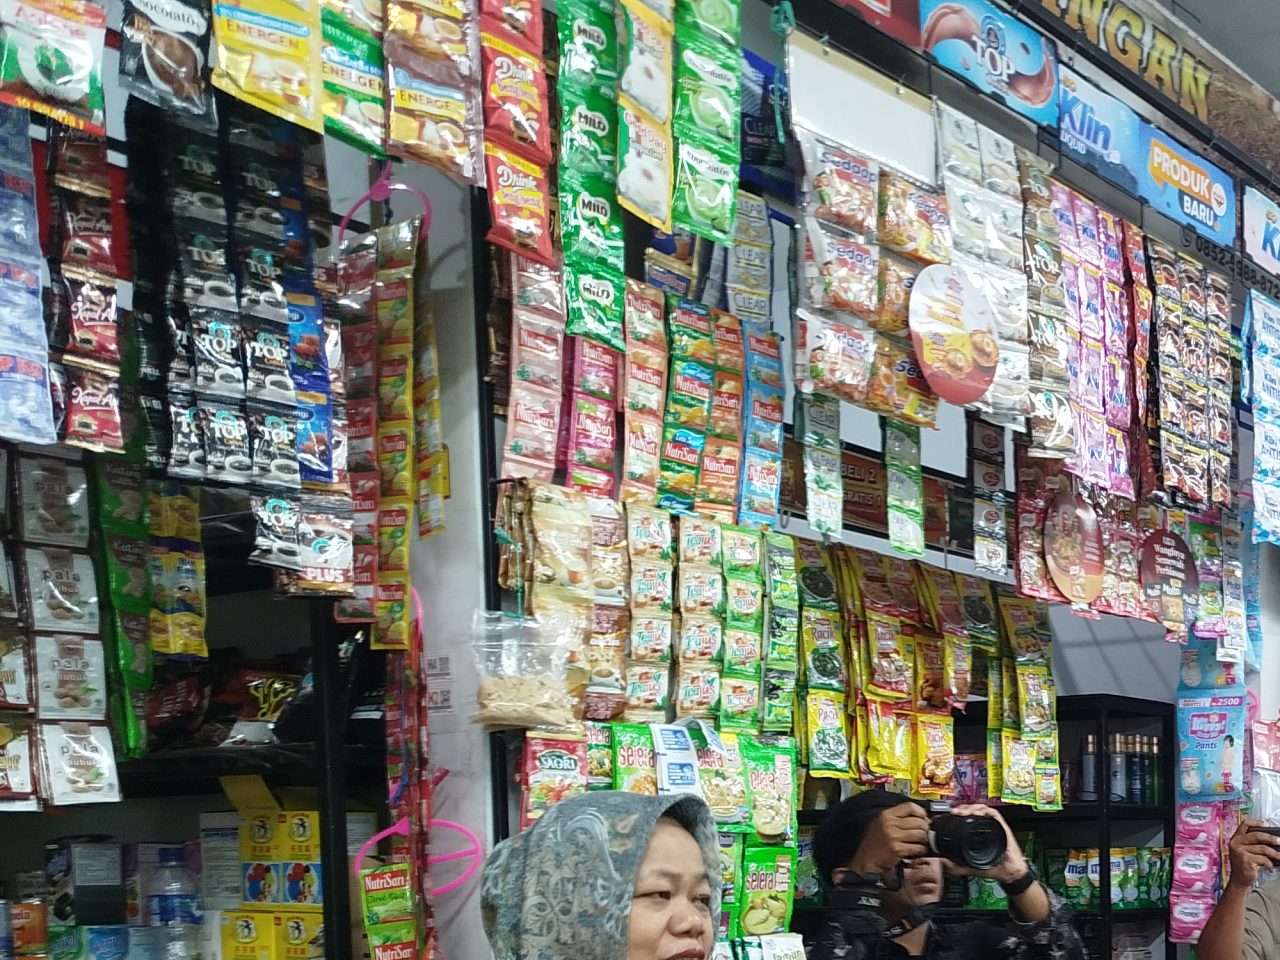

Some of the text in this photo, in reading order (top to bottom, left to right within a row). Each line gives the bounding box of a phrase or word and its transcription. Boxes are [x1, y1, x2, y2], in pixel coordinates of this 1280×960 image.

[226, 20, 300, 49] ENERGEN
[972, 33, 1016, 82] TOP
[1060, 89, 1113, 153] Klin
[1153, 148, 1212, 200] PRODUK
[1183, 195, 1216, 227] BARU
[306, 567, 344, 583] PLUS
[1217, 697, 1240, 706] 2500
[1195, 741, 1218, 751] Pants
[540, 755, 579, 771] SAORI
[365, 873, 406, 891] NutriSari
